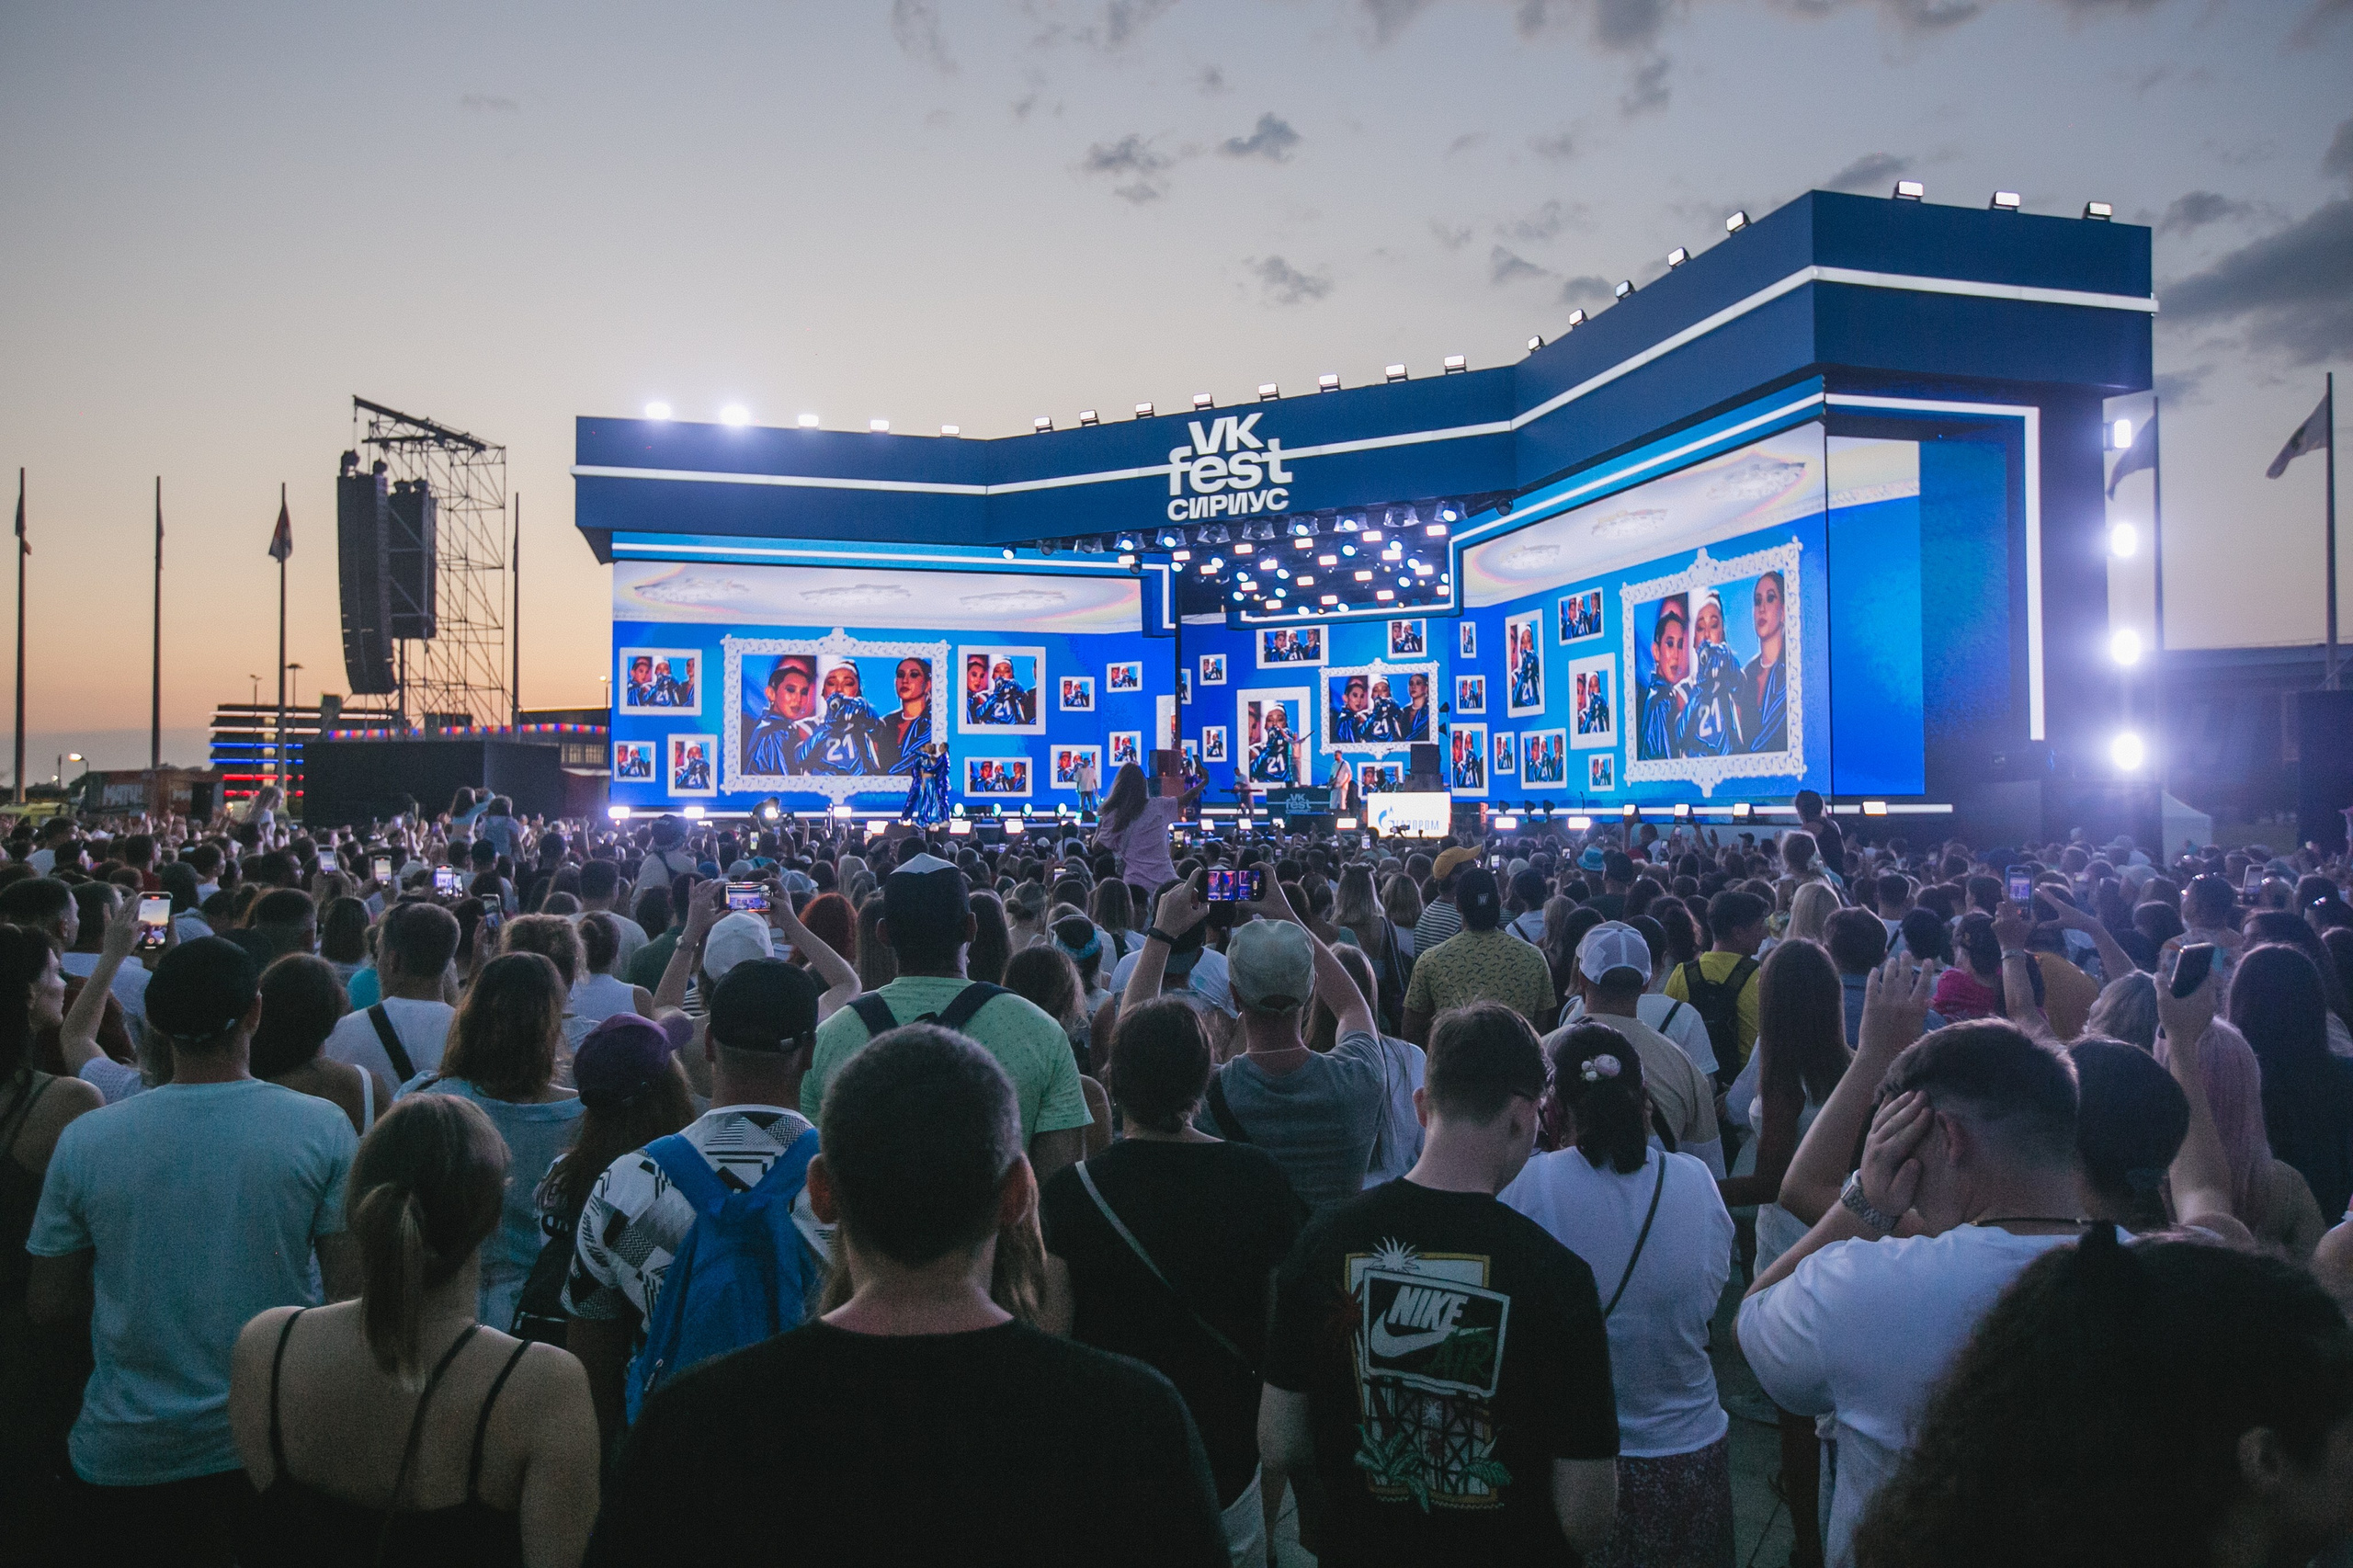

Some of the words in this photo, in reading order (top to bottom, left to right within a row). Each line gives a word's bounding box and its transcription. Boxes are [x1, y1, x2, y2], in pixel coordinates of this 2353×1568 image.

[1188, 412, 1264, 455] VK
[1168, 437, 1293, 496] fest
[1167, 487, 1290, 521] СИРИУС
[655, 689, 669, 702] 21
[994, 699, 1011, 717] 21
[1698, 697, 1722, 738] 21
[1372, 718, 1389, 734] 21
[826, 733, 855, 762] 21
[1267, 754, 1286, 773] 21
[688, 774, 701, 785] 21
[1286, 799, 1311, 810] fest
[1290, 793, 1305, 801] VK
[1387, 1285, 1470, 1330] NIKE
